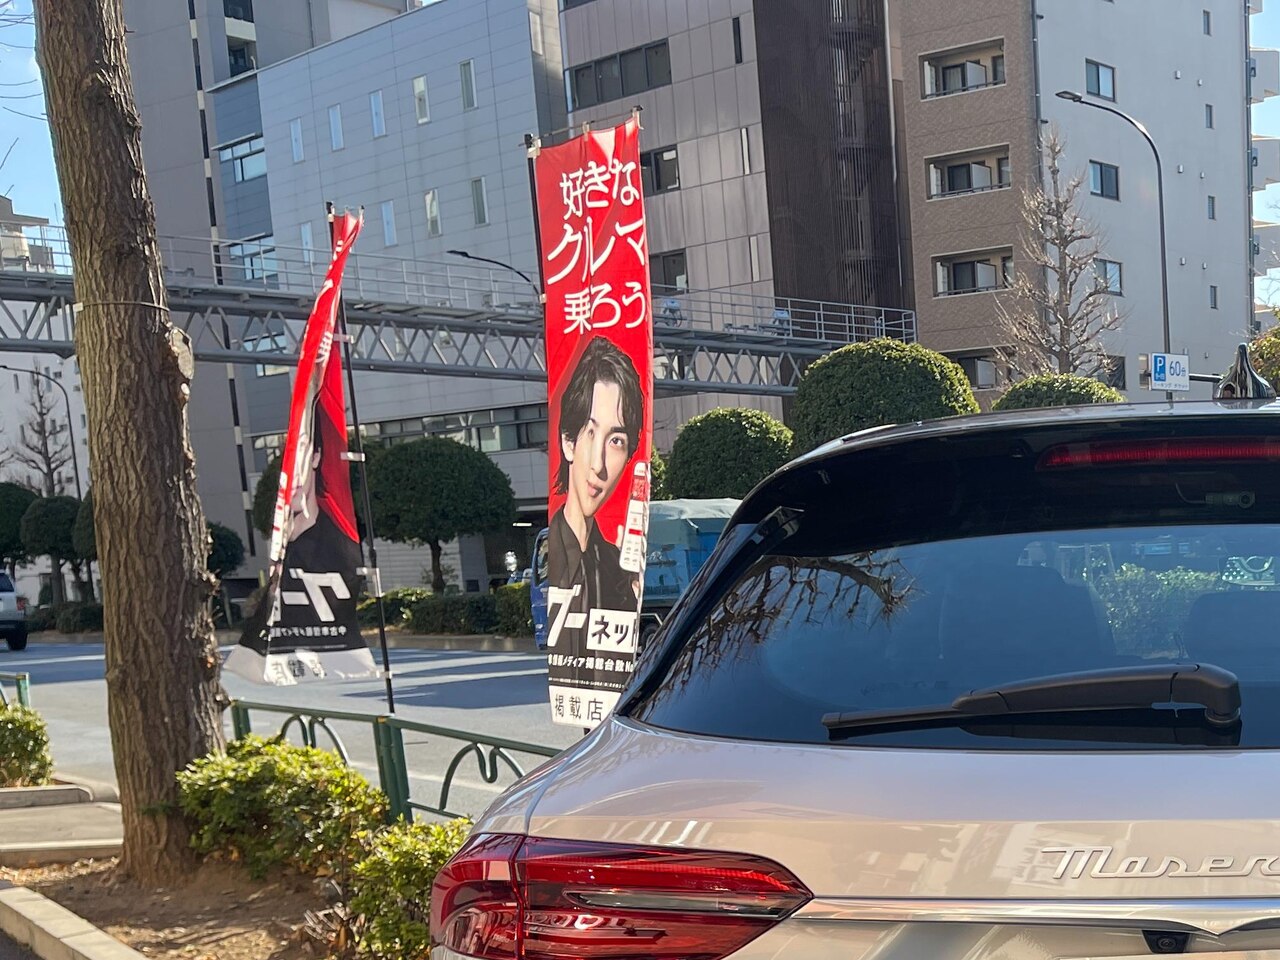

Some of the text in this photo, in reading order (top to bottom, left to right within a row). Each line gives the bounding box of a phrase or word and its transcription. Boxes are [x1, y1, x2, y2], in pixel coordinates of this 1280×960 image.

[560, 158, 640, 221] 好きな
[547, 216, 645, 285] クルマ
[563, 282, 646, 334] 乗ろう
[1157, 357, 1164, 372] P
